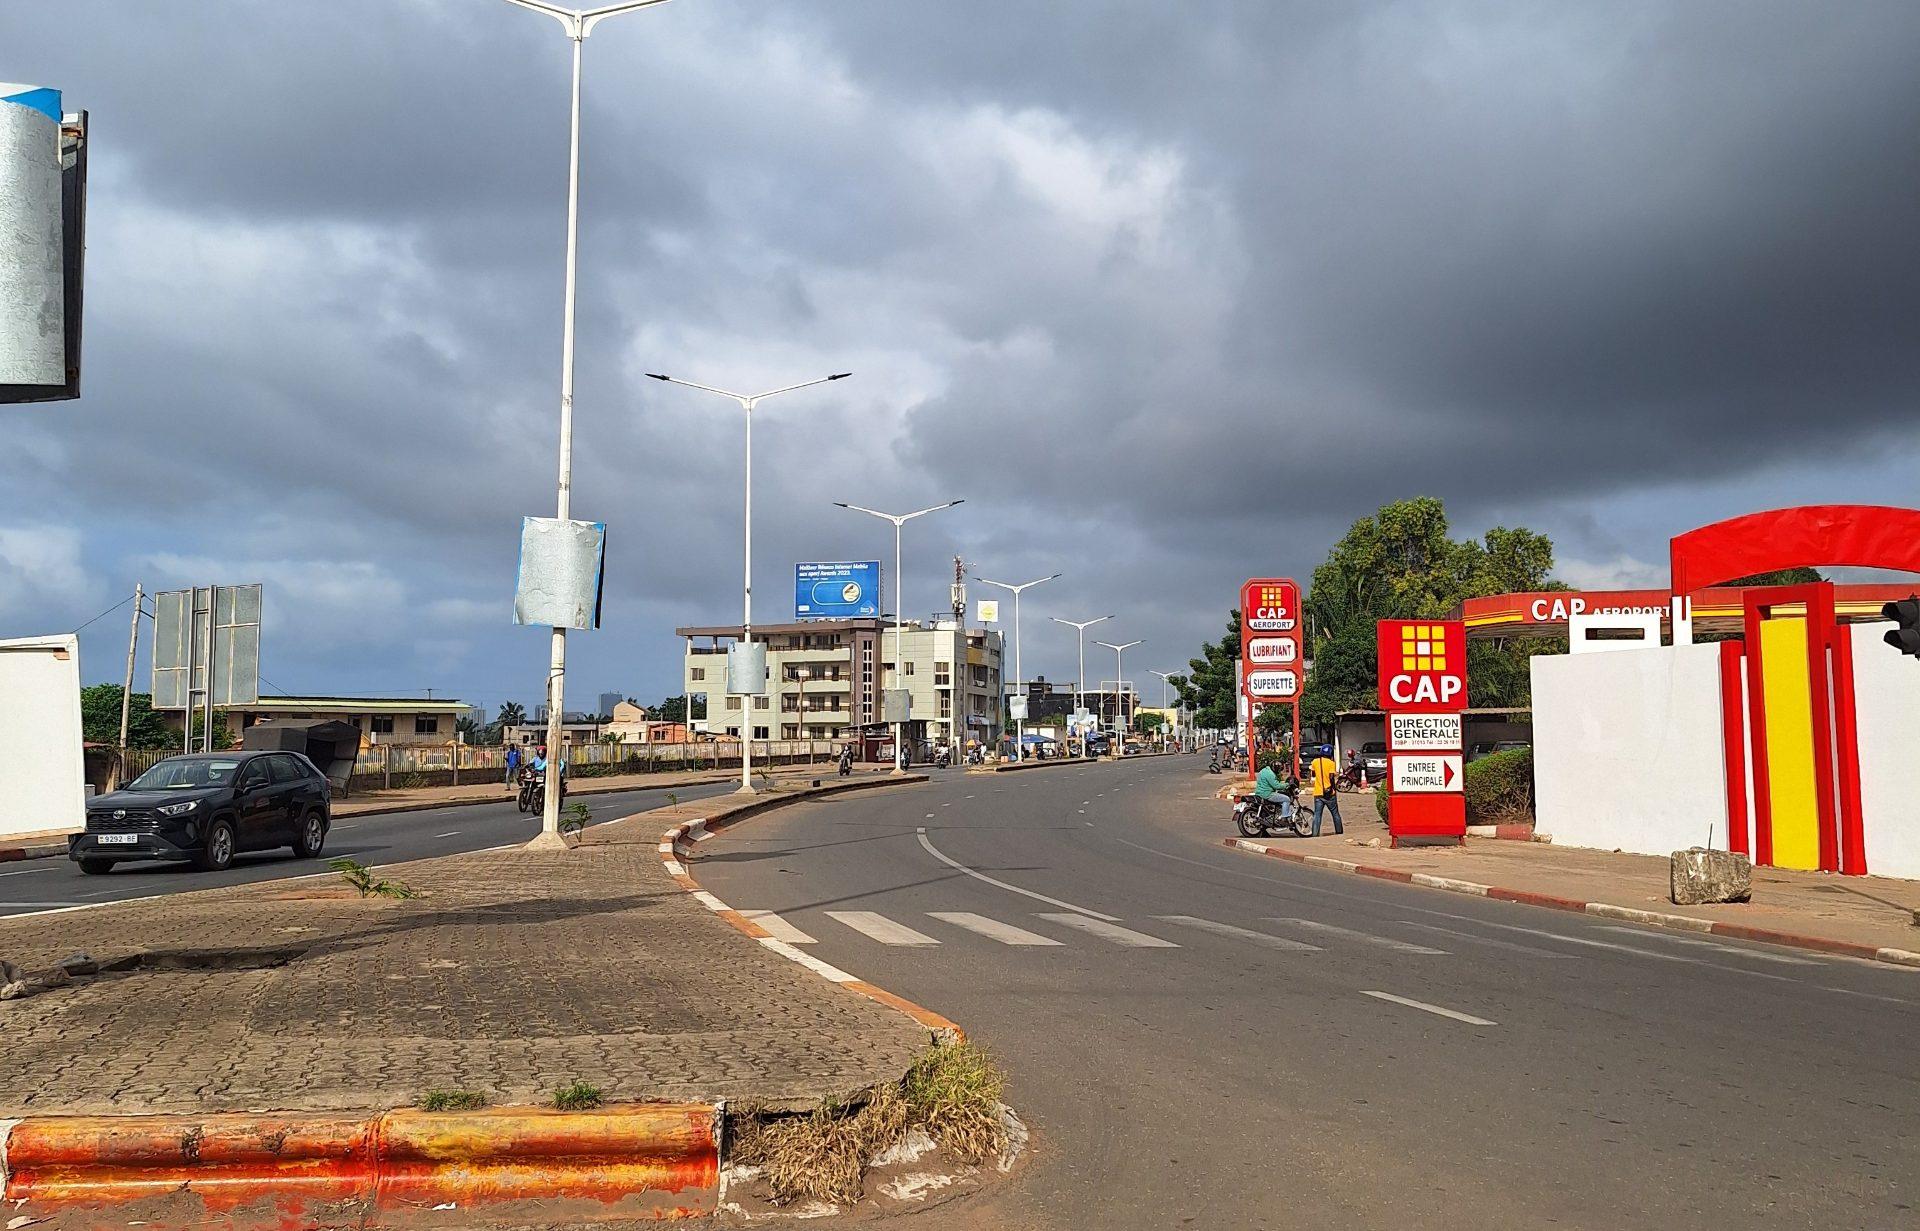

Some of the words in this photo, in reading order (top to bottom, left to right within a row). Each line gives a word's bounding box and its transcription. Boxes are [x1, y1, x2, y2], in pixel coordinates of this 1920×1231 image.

[1257, 607, 1286, 619] CAP
[1531, 598, 1586, 621] CAP
[1253, 621, 1291, 629] AEROPORT
[1252, 645, 1292, 657] LUBRIFIANT
[1253, 677, 1293, 690] SUPERETTE
[1389, 674, 1462, 703] CAP
[1394, 718, 1459, 729] DIRECTION
[1394, 729, 1460, 739] GENERALE
[1407, 762, 1436, 772] ENTREE
[1401, 776, 1443, 786] PRINCIPALE
